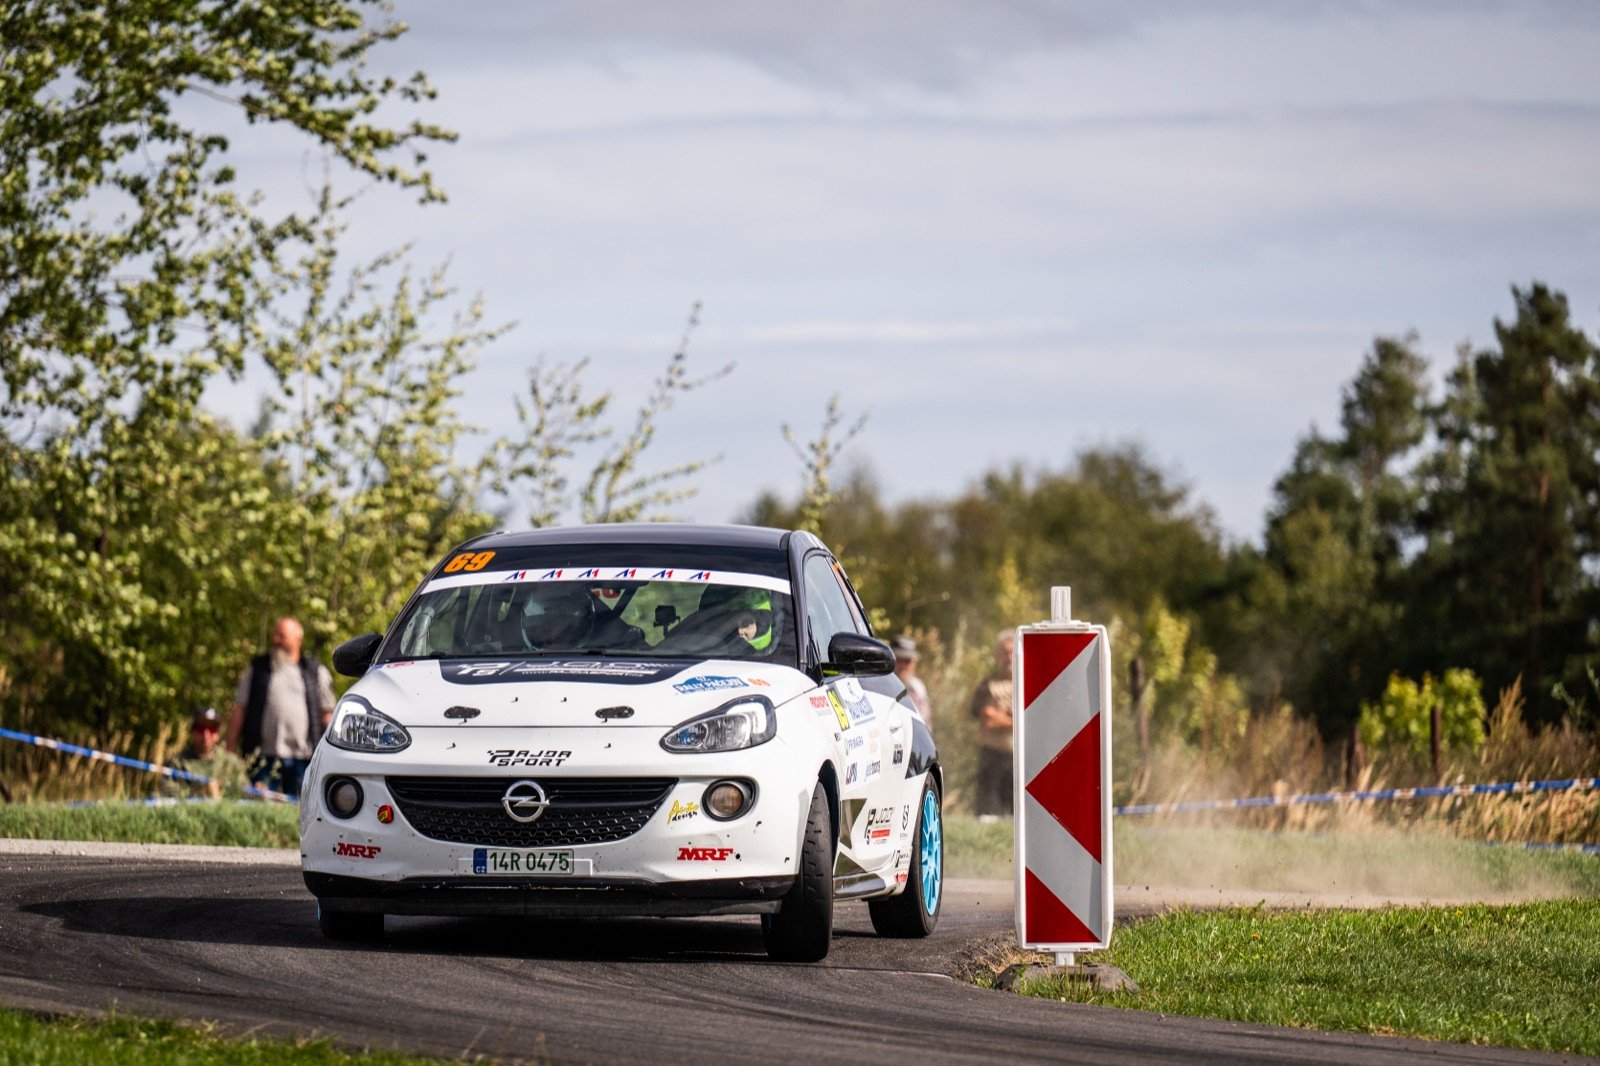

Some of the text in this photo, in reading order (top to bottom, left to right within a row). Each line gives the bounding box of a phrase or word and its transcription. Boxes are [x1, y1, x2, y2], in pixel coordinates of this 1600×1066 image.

[444, 551, 497, 573] 69
[497, 758, 566, 767] SPORT
[672, 811, 698, 821] design
[336, 842, 381, 859] MRF
[677, 847, 734, 861] MRF
[489, 852, 570, 871] 14R 0475
[475, 865, 486, 873] CZ
